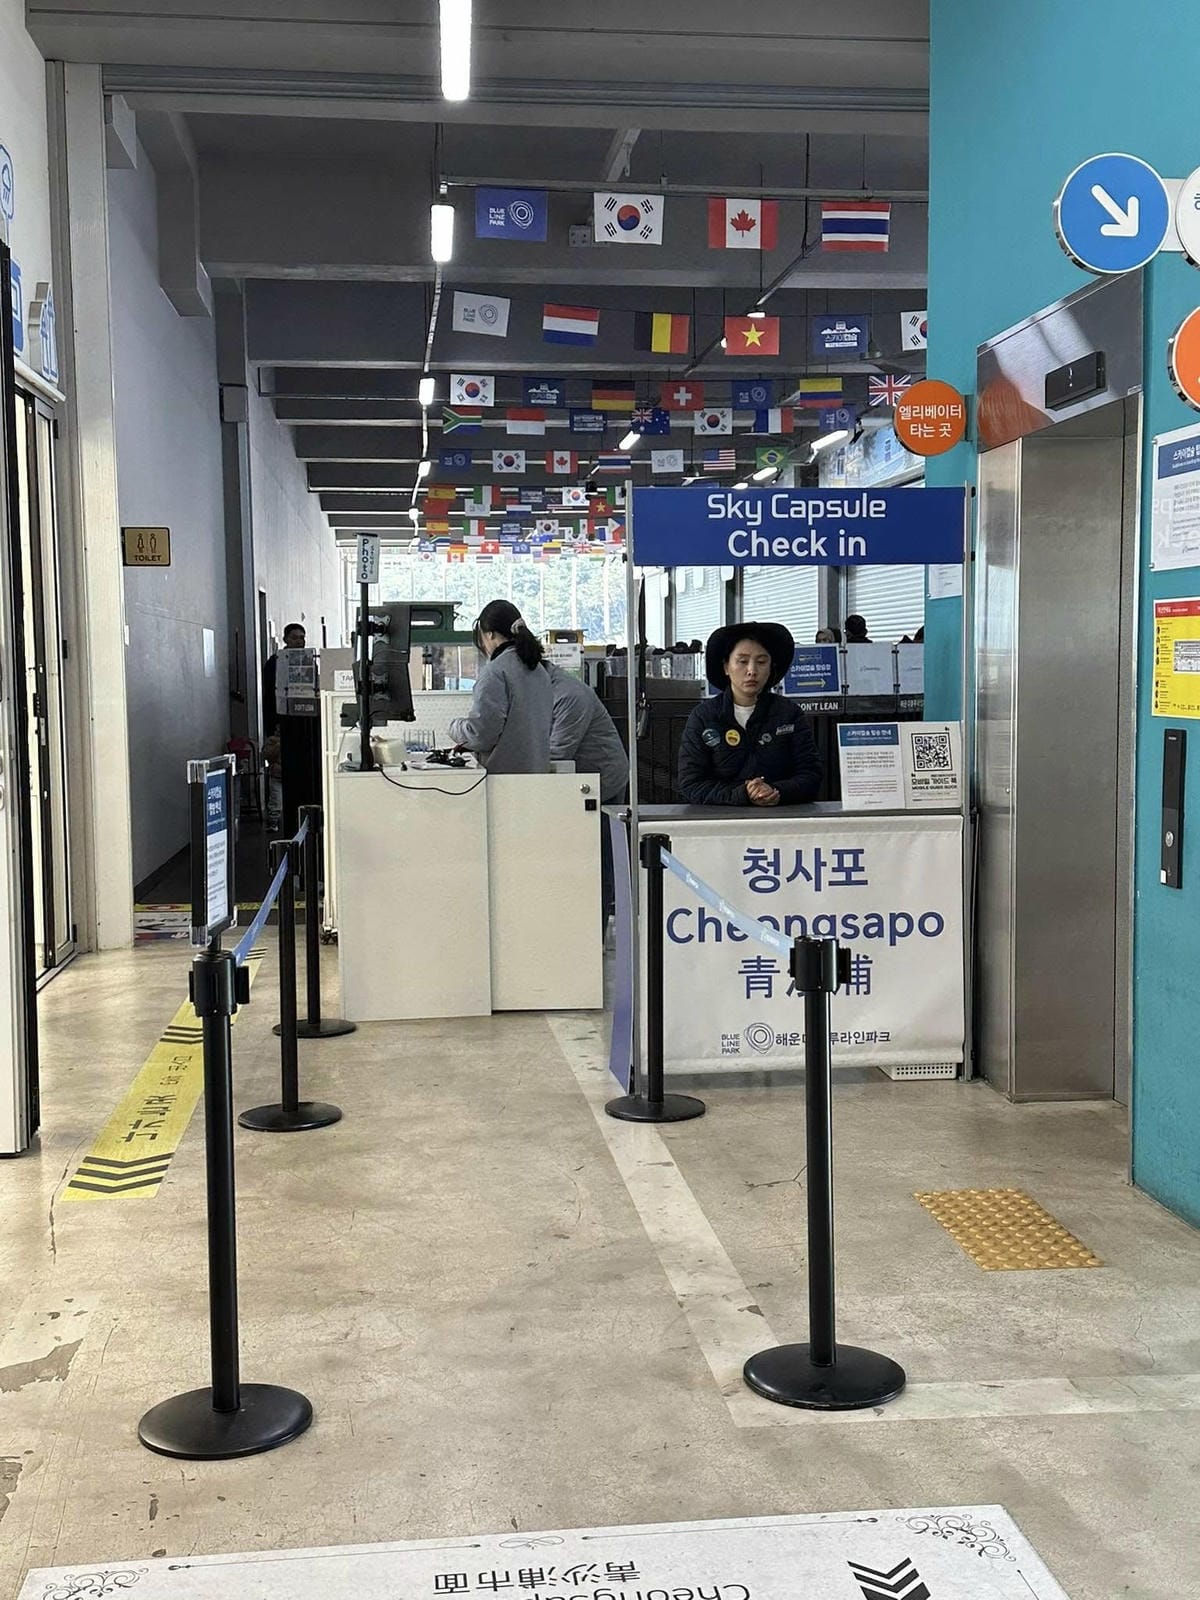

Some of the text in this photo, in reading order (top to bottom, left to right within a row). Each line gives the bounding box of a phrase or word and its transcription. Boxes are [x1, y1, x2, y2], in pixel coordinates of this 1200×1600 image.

[899, 404, 962, 420] 엘리베이터
[910, 422, 952, 438] 타는 곳
[707, 493, 886, 525] Sky Capsule
[728, 529, 866, 557] Check in
[798, 702, 839, 711] ON'T LEAN
[742, 847, 869, 893] 청사포
[721, 1033, 740, 1041] BLUE
[775, 1031, 891, 1046] 해운루라인파크
